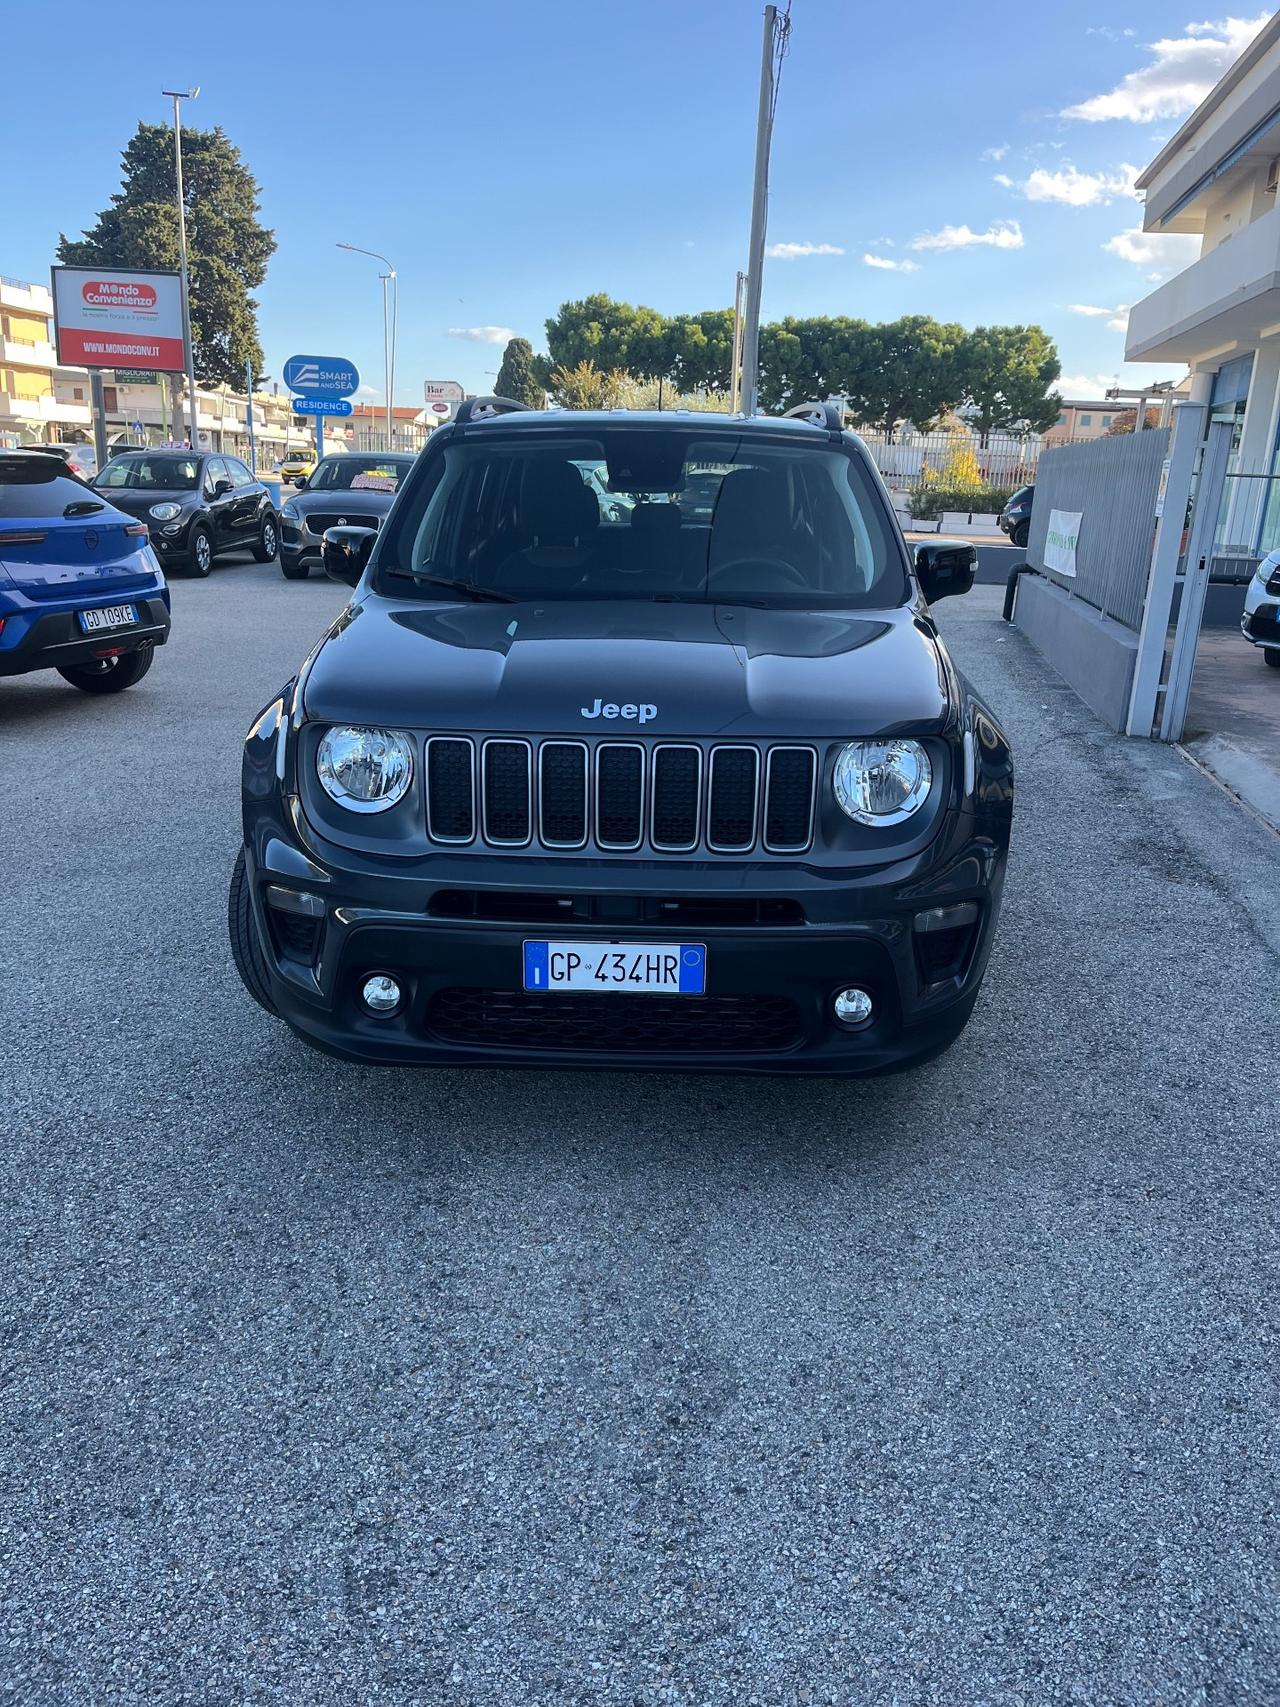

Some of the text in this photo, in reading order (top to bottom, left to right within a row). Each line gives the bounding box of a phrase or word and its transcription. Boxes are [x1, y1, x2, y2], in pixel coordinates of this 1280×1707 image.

[99, 284, 139, 295] Mondo
[86, 293, 153, 306] Convenienza
[83, 342, 160, 356] WWW.MONDOCONV.IT
[320, 371, 353, 381] SMART
[427, 385, 445, 393] Bar
[296, 400, 348, 411] RESIDENCE
[86, 611, 100, 628] GD
[581, 699, 658, 724] Jeep
